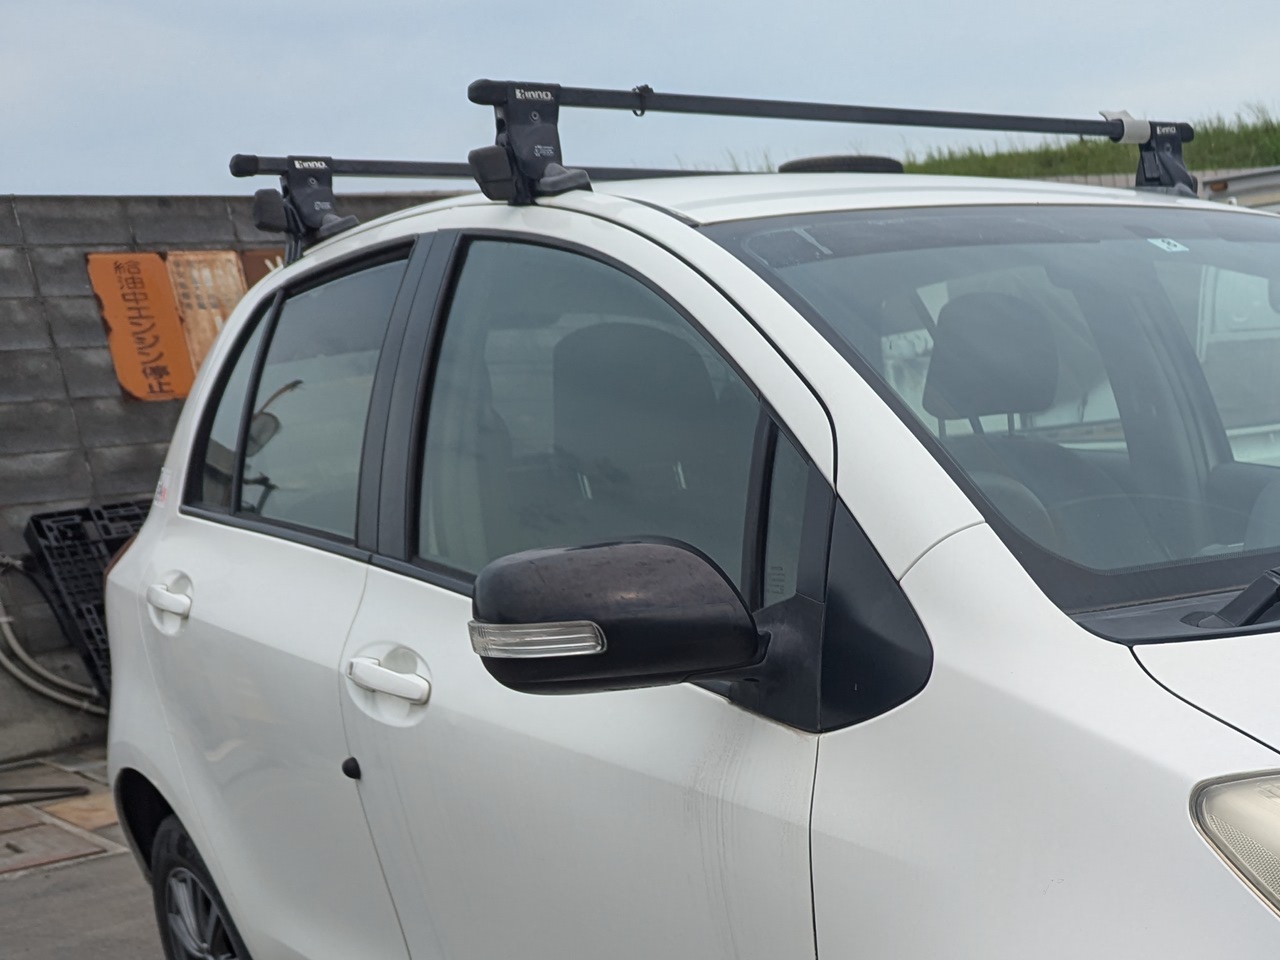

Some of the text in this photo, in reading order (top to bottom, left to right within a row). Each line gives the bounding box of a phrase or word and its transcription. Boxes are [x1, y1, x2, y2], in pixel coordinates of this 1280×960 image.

[113, 260, 174, 396] 給油中エンジン停止
